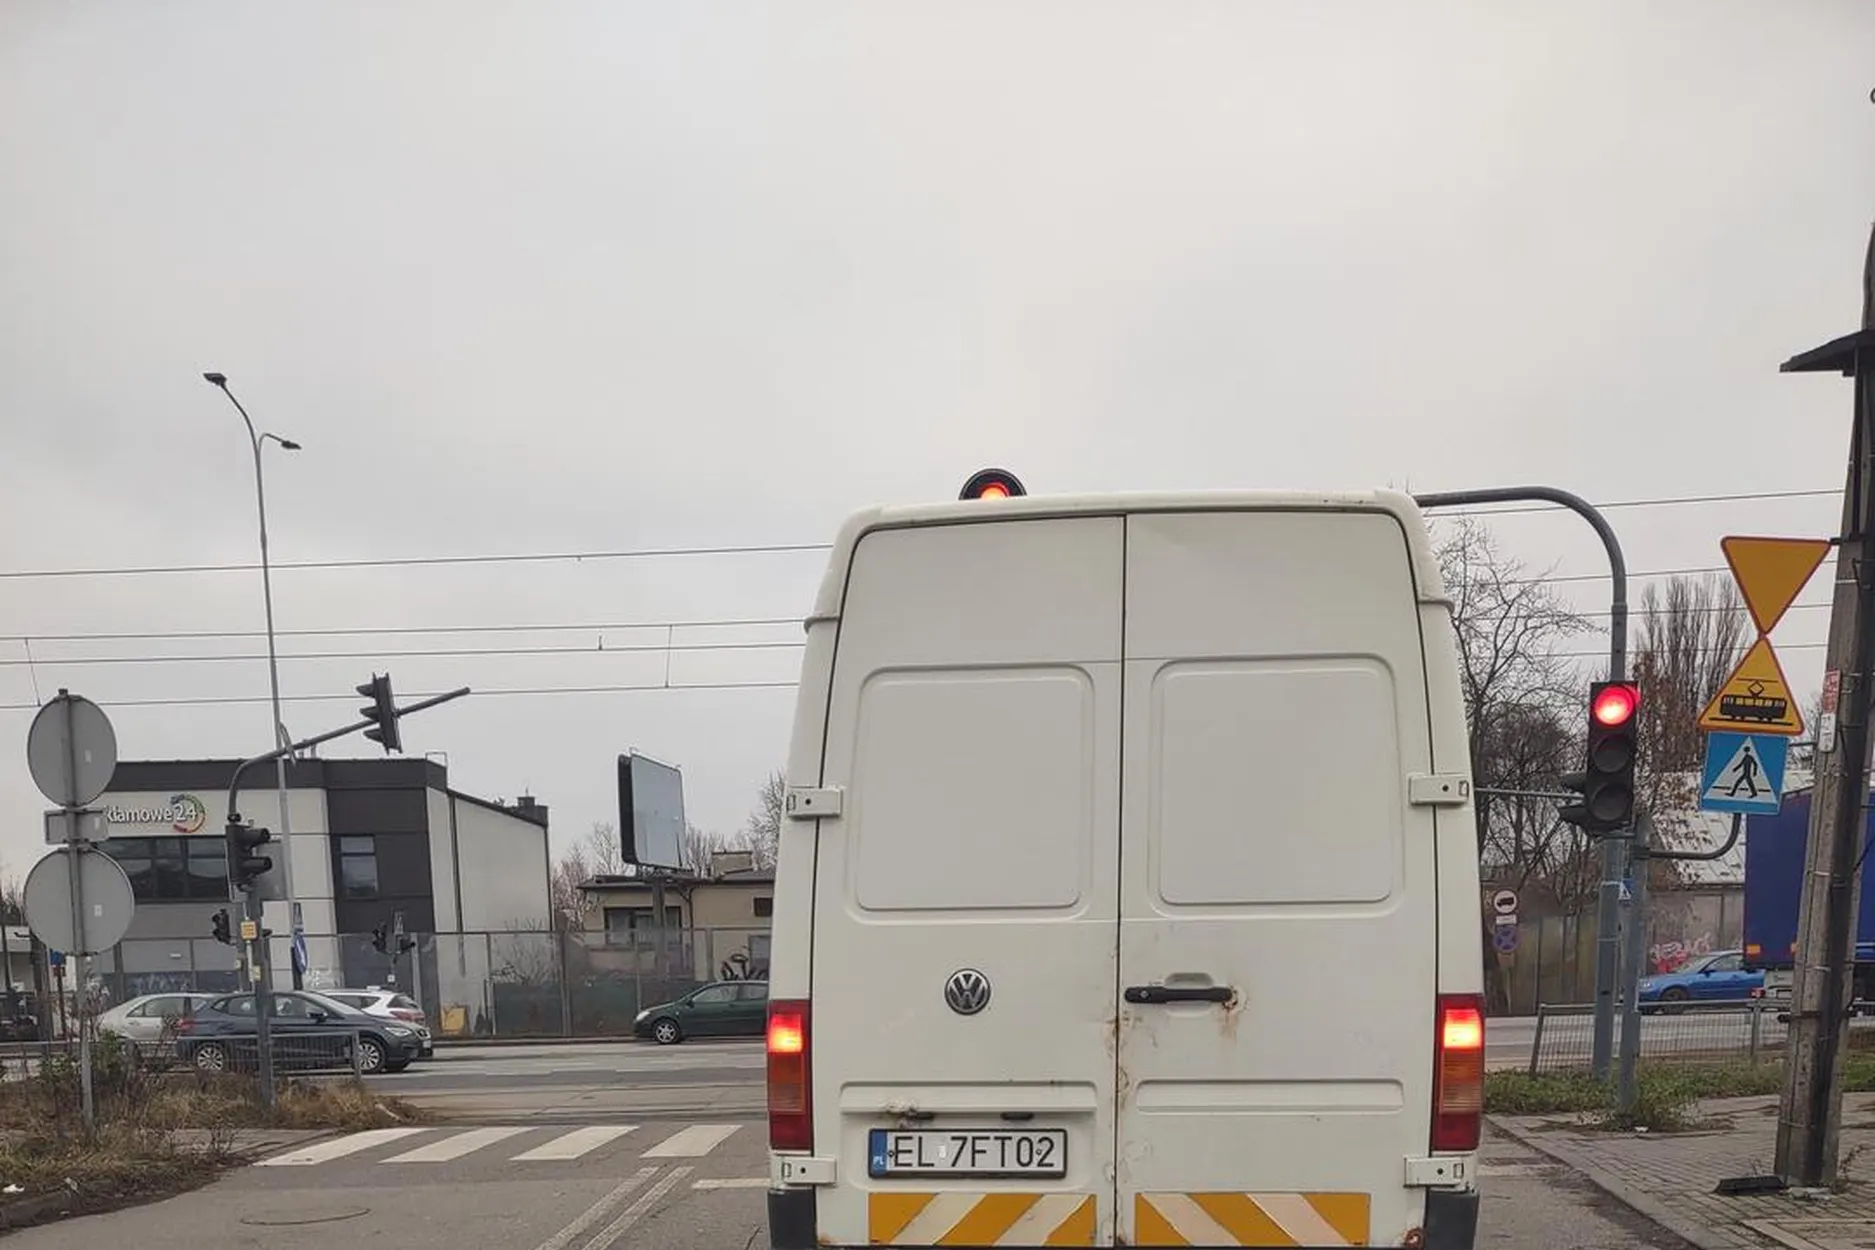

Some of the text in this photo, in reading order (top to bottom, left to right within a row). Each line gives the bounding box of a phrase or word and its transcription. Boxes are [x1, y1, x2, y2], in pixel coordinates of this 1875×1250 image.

[947, 970, 988, 1013] VW
[872, 1155, 884, 1166] PL
[894, 1136, 1055, 1167] EL 7FT02
